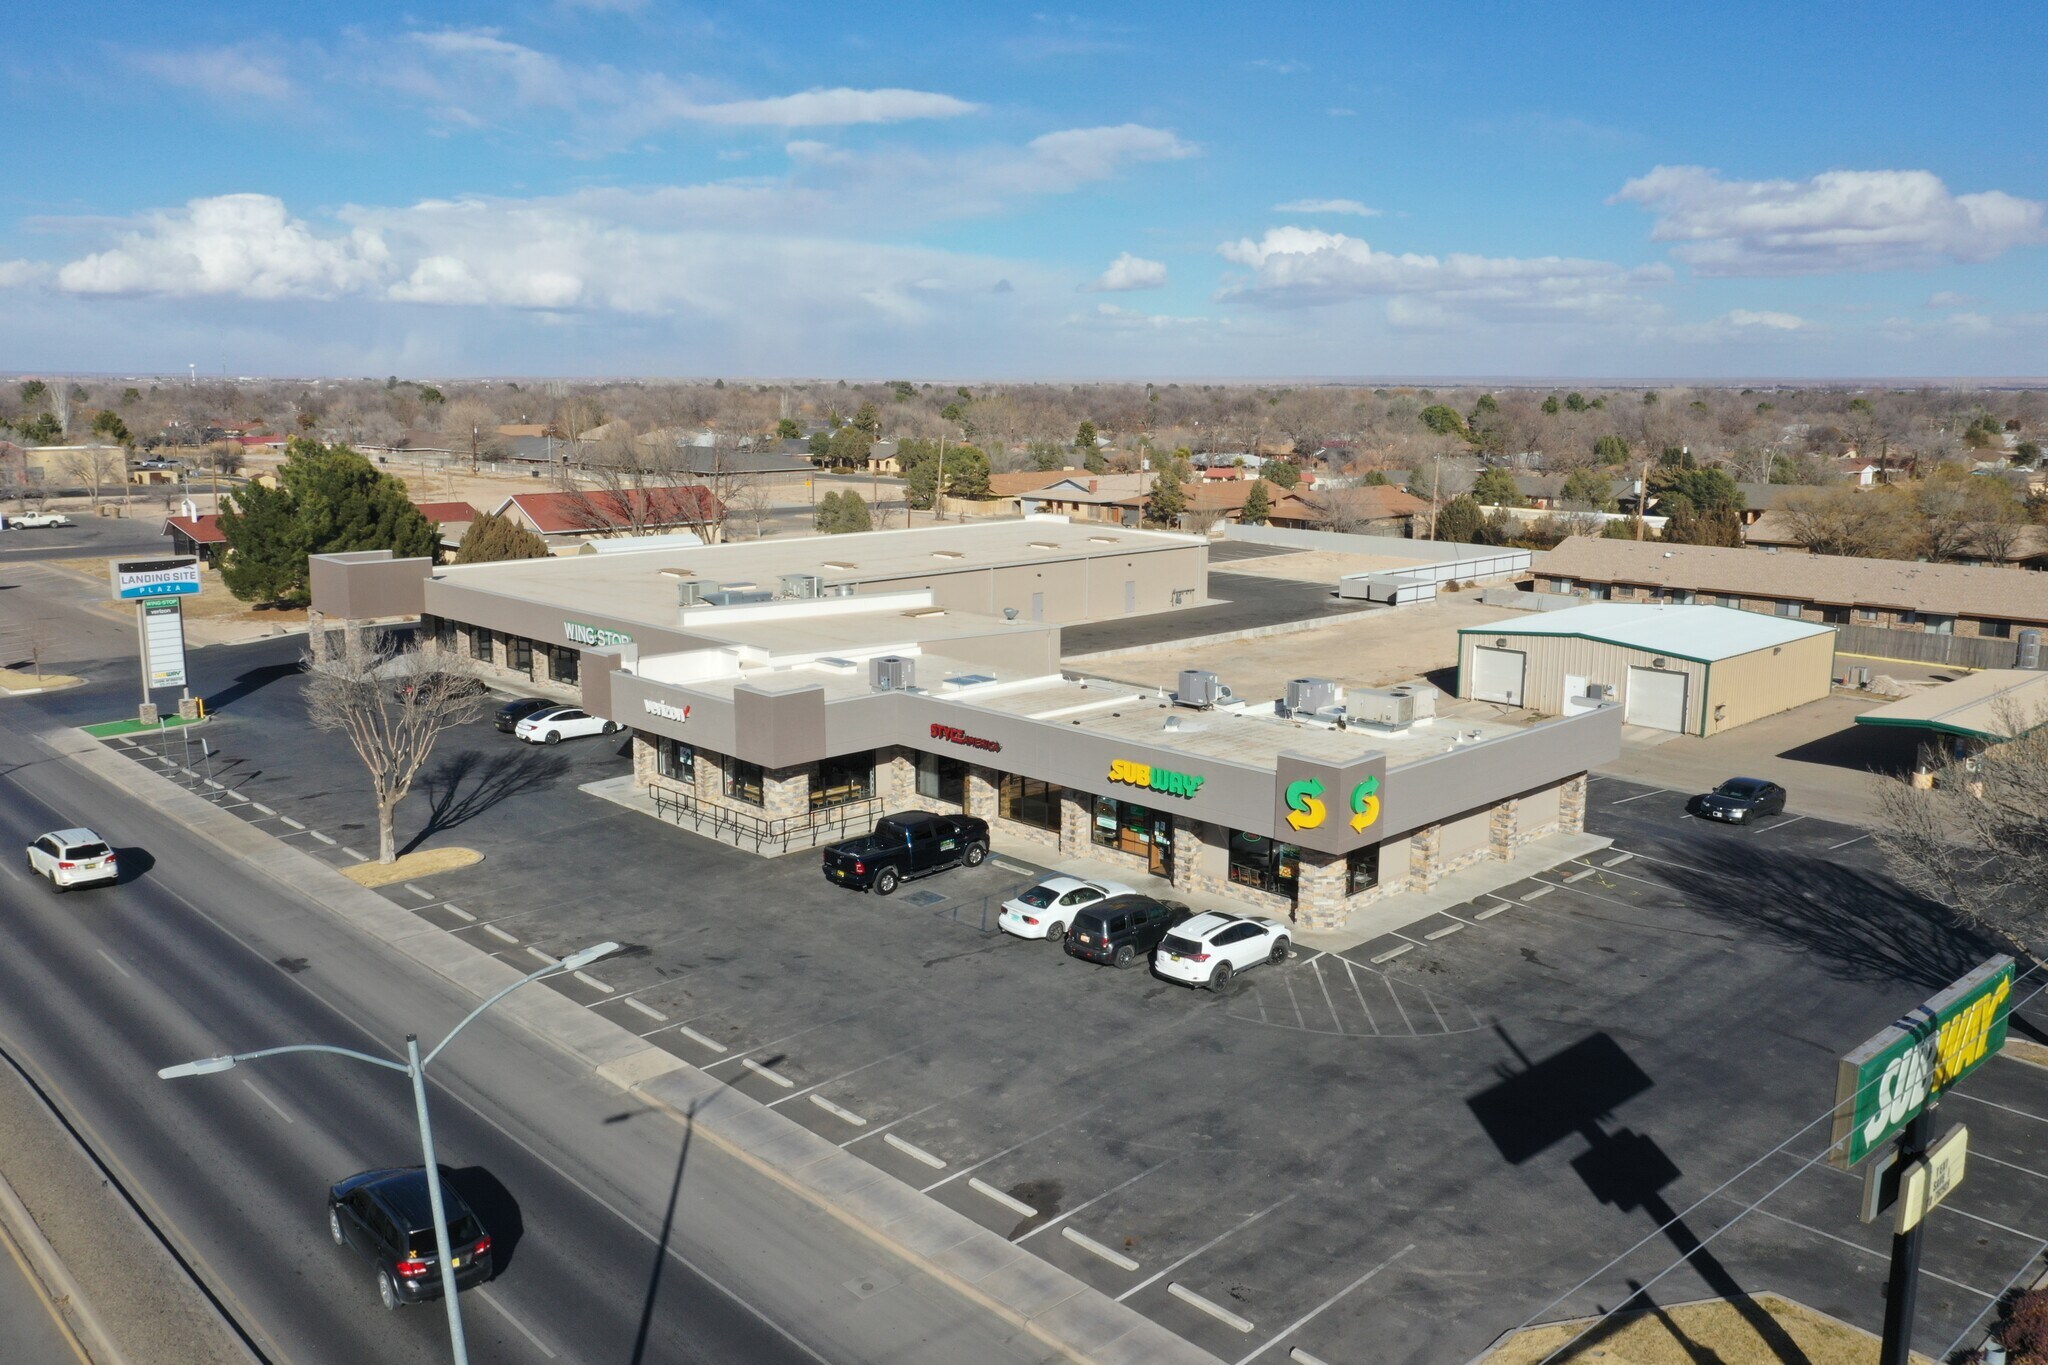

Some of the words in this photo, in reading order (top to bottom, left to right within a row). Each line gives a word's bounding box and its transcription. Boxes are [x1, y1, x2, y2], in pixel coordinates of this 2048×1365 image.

[121, 573, 170, 584] LANDING
[172, 571, 196, 581] SITE
[140, 585, 181, 594] PLAZA
[643, 699, 686, 723] verizon
[1108, 758, 1204, 798] SUBWAY
[1863, 974, 2011, 1149] SUBWAY
